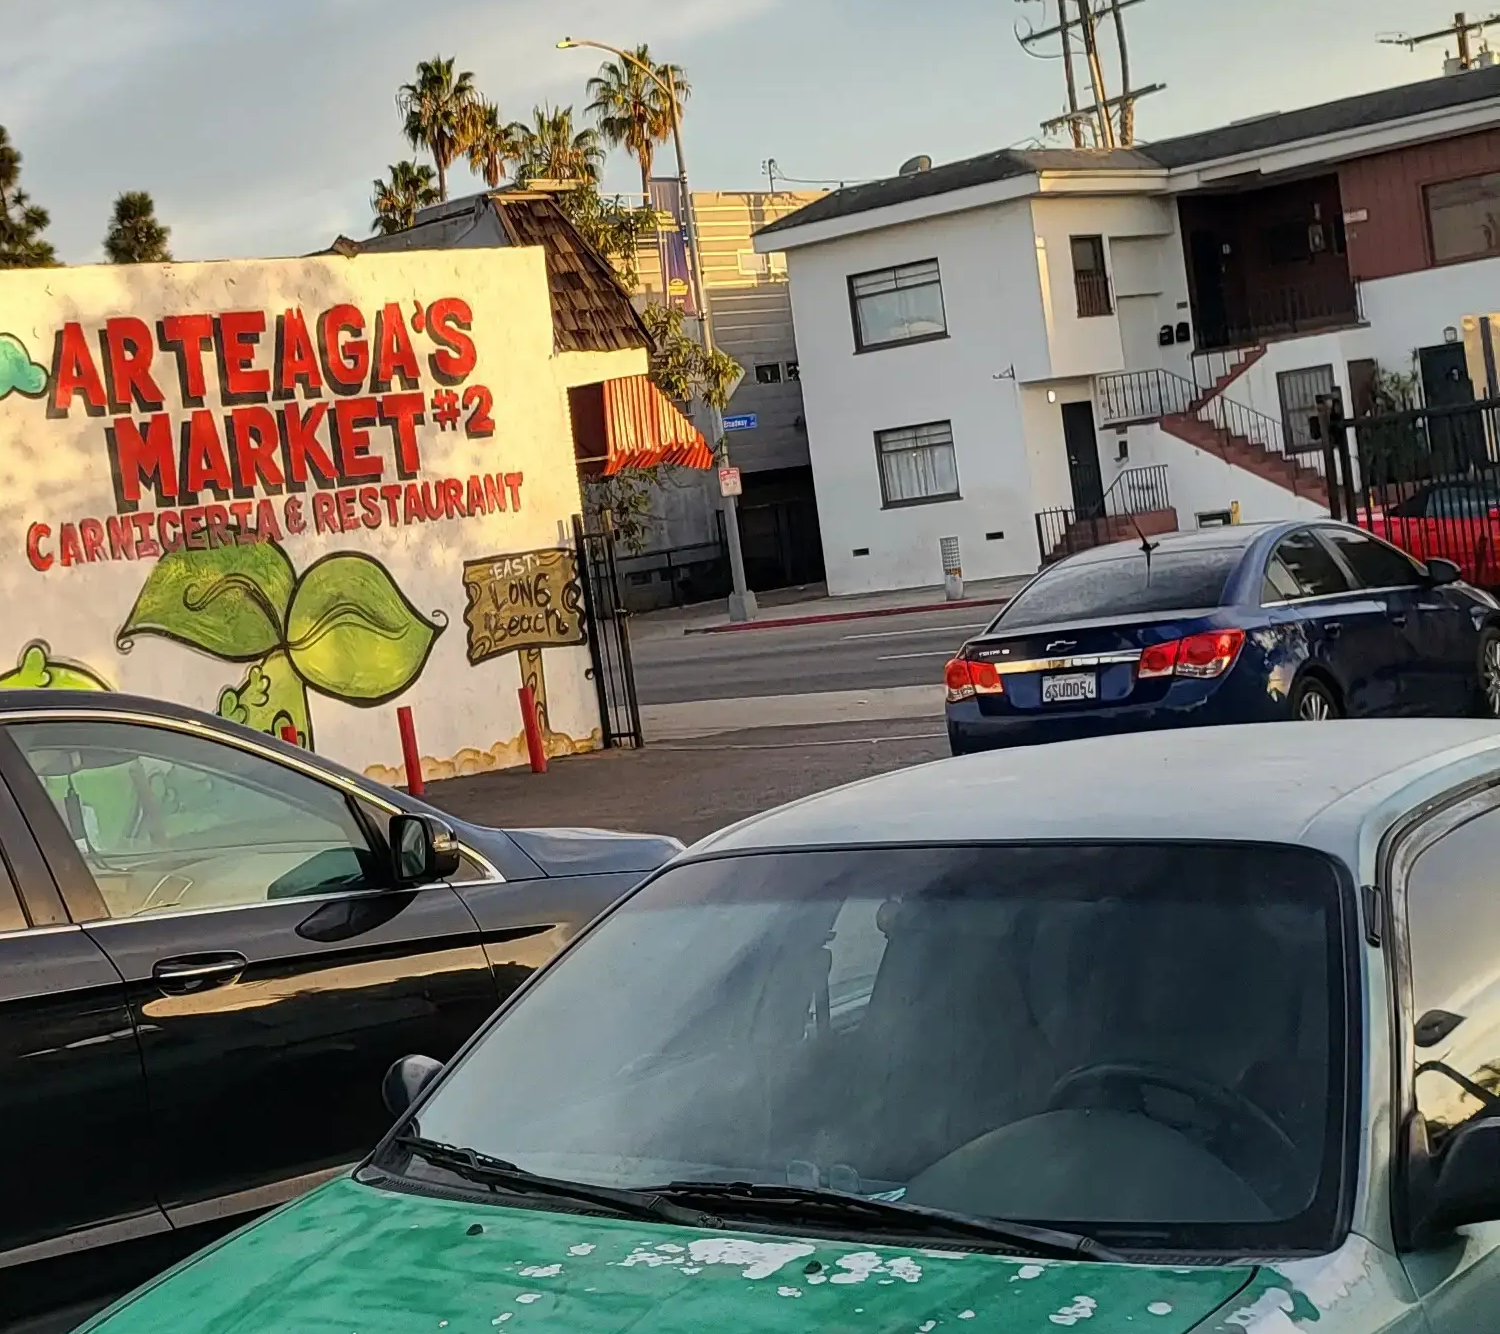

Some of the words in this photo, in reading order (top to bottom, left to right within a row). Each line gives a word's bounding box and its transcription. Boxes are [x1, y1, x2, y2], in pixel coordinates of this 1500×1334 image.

[47, 297, 477, 419] ARTEAGA'S
[104, 392, 426, 512] MARKET
[431, 384, 496, 439] #2
[27, 499, 284, 571] CARNICERIA
[284, 496, 307, 535] &
[312, 471, 524, 535] RESTAURANT
[488, 572, 551, 612] LONG
